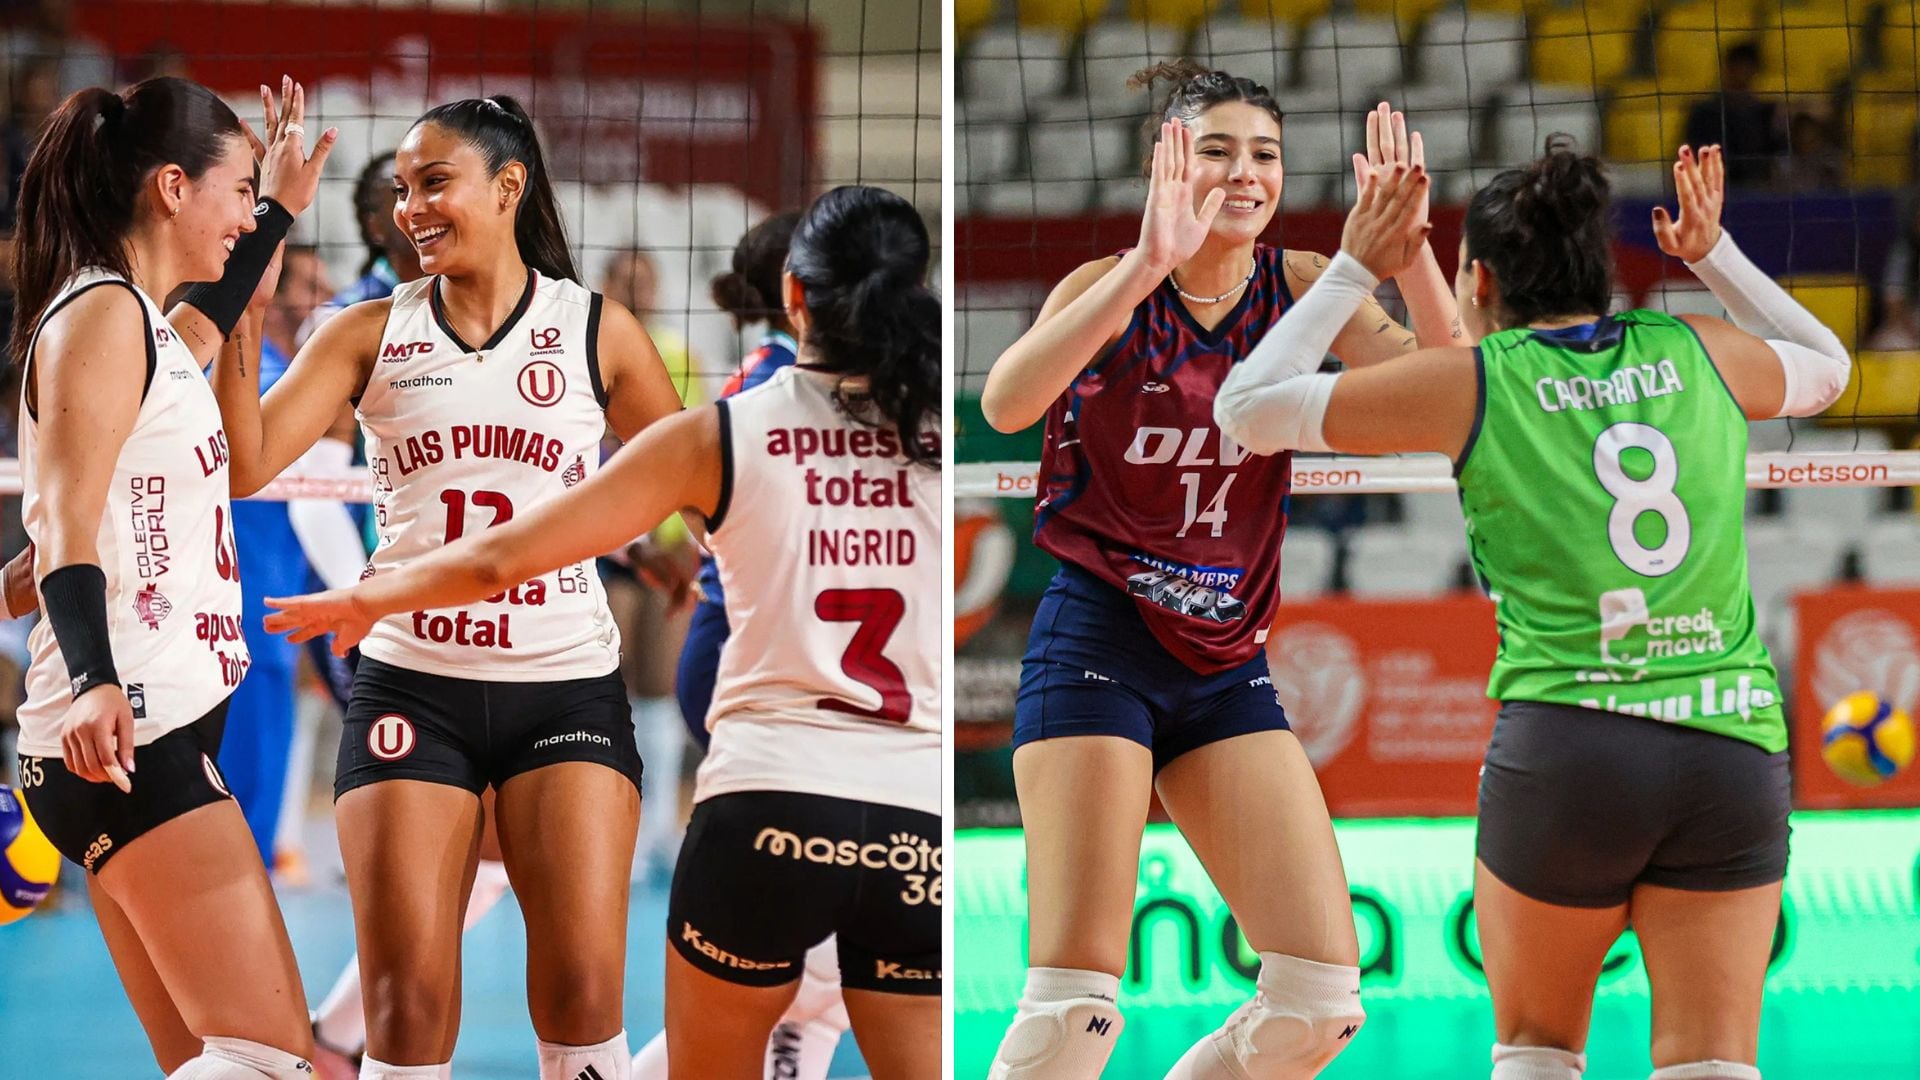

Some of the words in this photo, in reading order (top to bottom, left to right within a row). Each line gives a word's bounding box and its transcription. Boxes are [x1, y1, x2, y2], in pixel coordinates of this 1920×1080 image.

[383, 341, 435, 357] MTD
[390, 375, 453, 390] marathon
[1535, 359, 1684, 413] CARRANZA
[194, 429, 229, 478] LAS
[393, 430, 444, 477] LAS
[451, 424, 564, 473] PUMAS
[1124, 426, 1255, 467] OLV
[805, 468, 914, 508] total
[1294, 469, 1361, 487] sson
[1768, 462, 1888, 483] betsson
[1176, 472, 1238, 538] 14
[1592, 421, 1691, 578] 8
[131, 476, 151, 578] COLECTIVO
[147, 476, 170, 577] WORLD
[809, 528, 916, 567] INGRID
[412, 610, 513, 648] total
[1646, 607, 1714, 636] credi
[814, 587, 913, 725] 3
[534, 730, 611, 749] marathon
